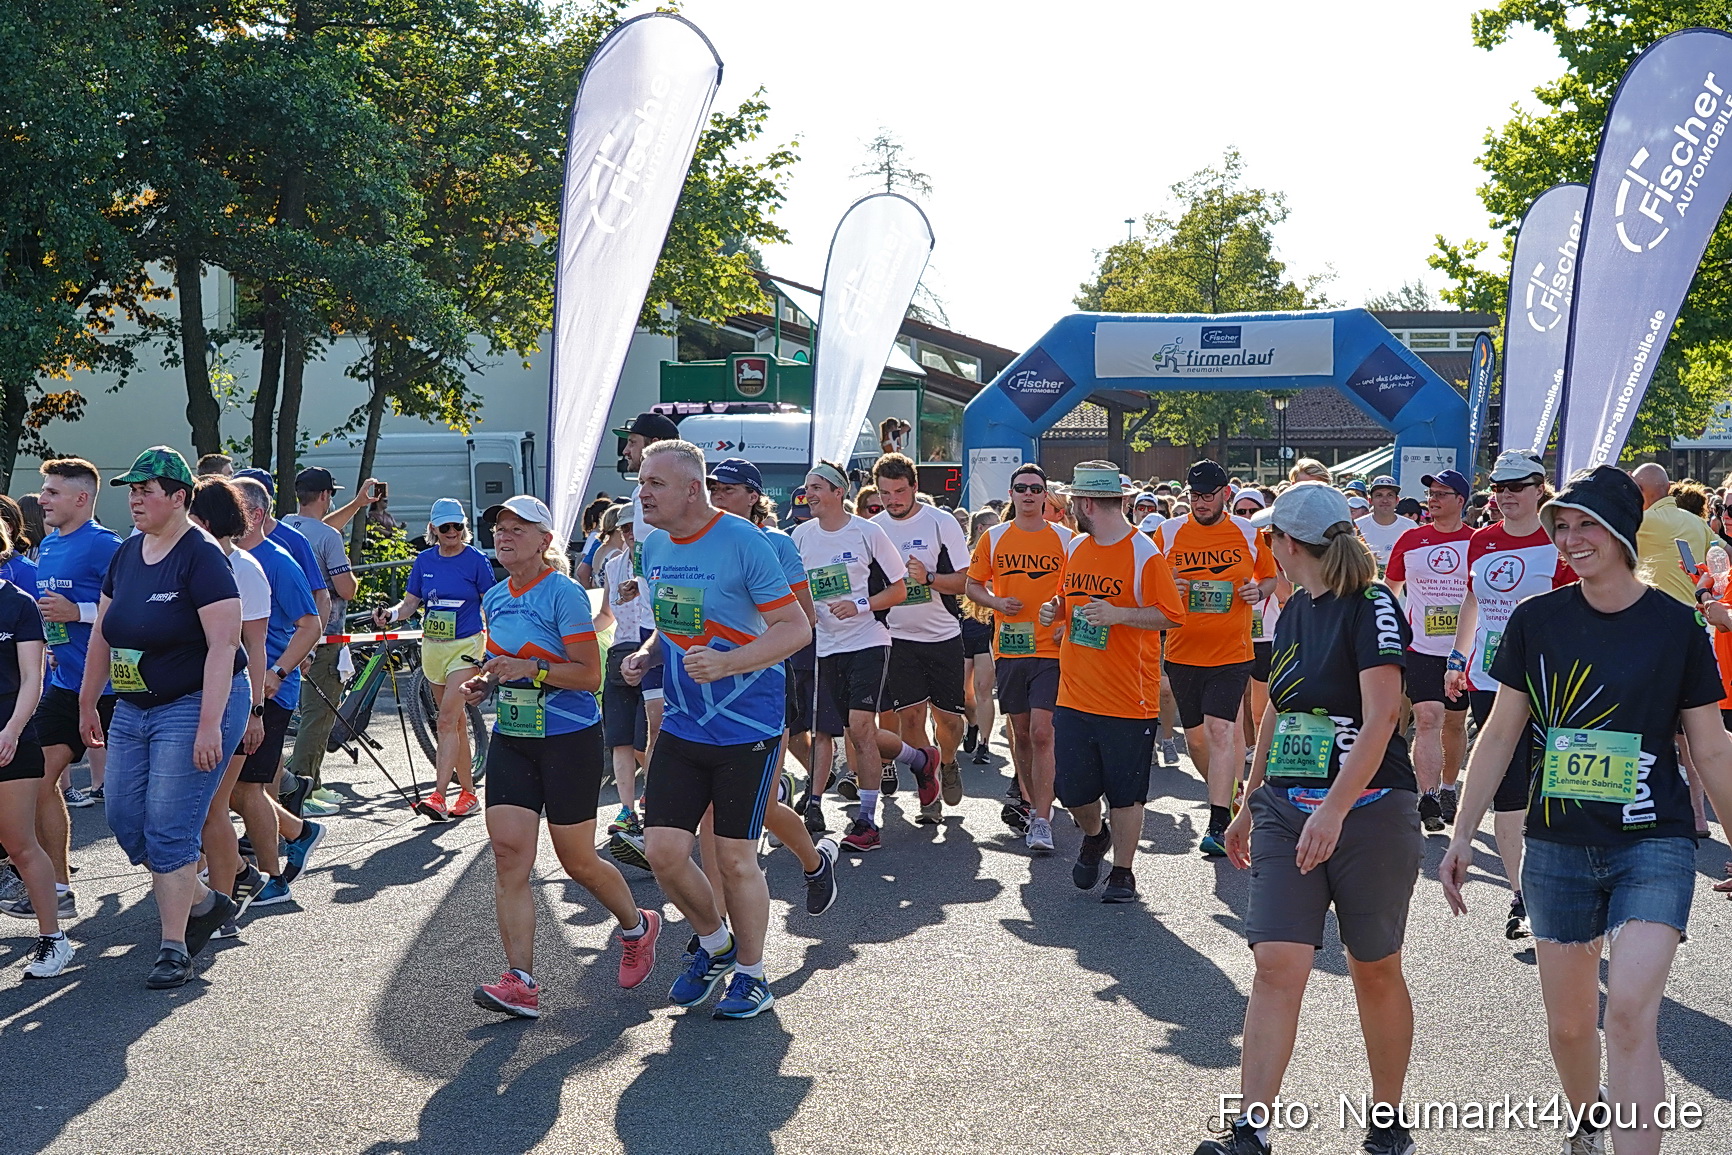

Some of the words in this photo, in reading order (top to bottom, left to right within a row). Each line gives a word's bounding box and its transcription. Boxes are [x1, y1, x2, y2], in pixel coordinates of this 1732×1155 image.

[609, 74, 671, 204] Fische
[1639, 72, 1723, 224] Fischer
[1676, 94, 1732, 217] AUTOMOBILE
[853, 220, 902, 317] Fischer
[1541, 210, 1582, 312] Fischer
[1209, 333, 1239, 341] Fischer
[1187, 348, 1275, 366] firmenlauf
[1016, 378, 1064, 389] Fischer
[1004, 554, 1060, 571] WINGS
[1184, 549, 1242, 565] WINGS
[818, 576, 838, 589] 541
[1071, 573, 1124, 596] WINGS
[1199, 591, 1222, 602] 379
[671, 602, 679, 618] 4
[429, 620, 446, 631] 790
[1075, 619, 1097, 635] 343
[1431, 615, 1458, 626] 1501
[1004, 634, 1024, 644] 513
[113, 664, 131, 678] 893
[510, 705, 518, 720] 9
[1271, 742, 1279, 763] RUN
[1282, 735, 1312, 755] 666
[1297, 757, 1315, 766] Agnes
[1318, 740, 1329, 768] 2022
[1548, 755, 1559, 788] WALK
[1567, 753, 1611, 778] 671
[1556, 777, 1590, 785] Lehmeier
[1592, 779, 1623, 789] Sabrina
[1623, 761, 1634, 793] 2022
